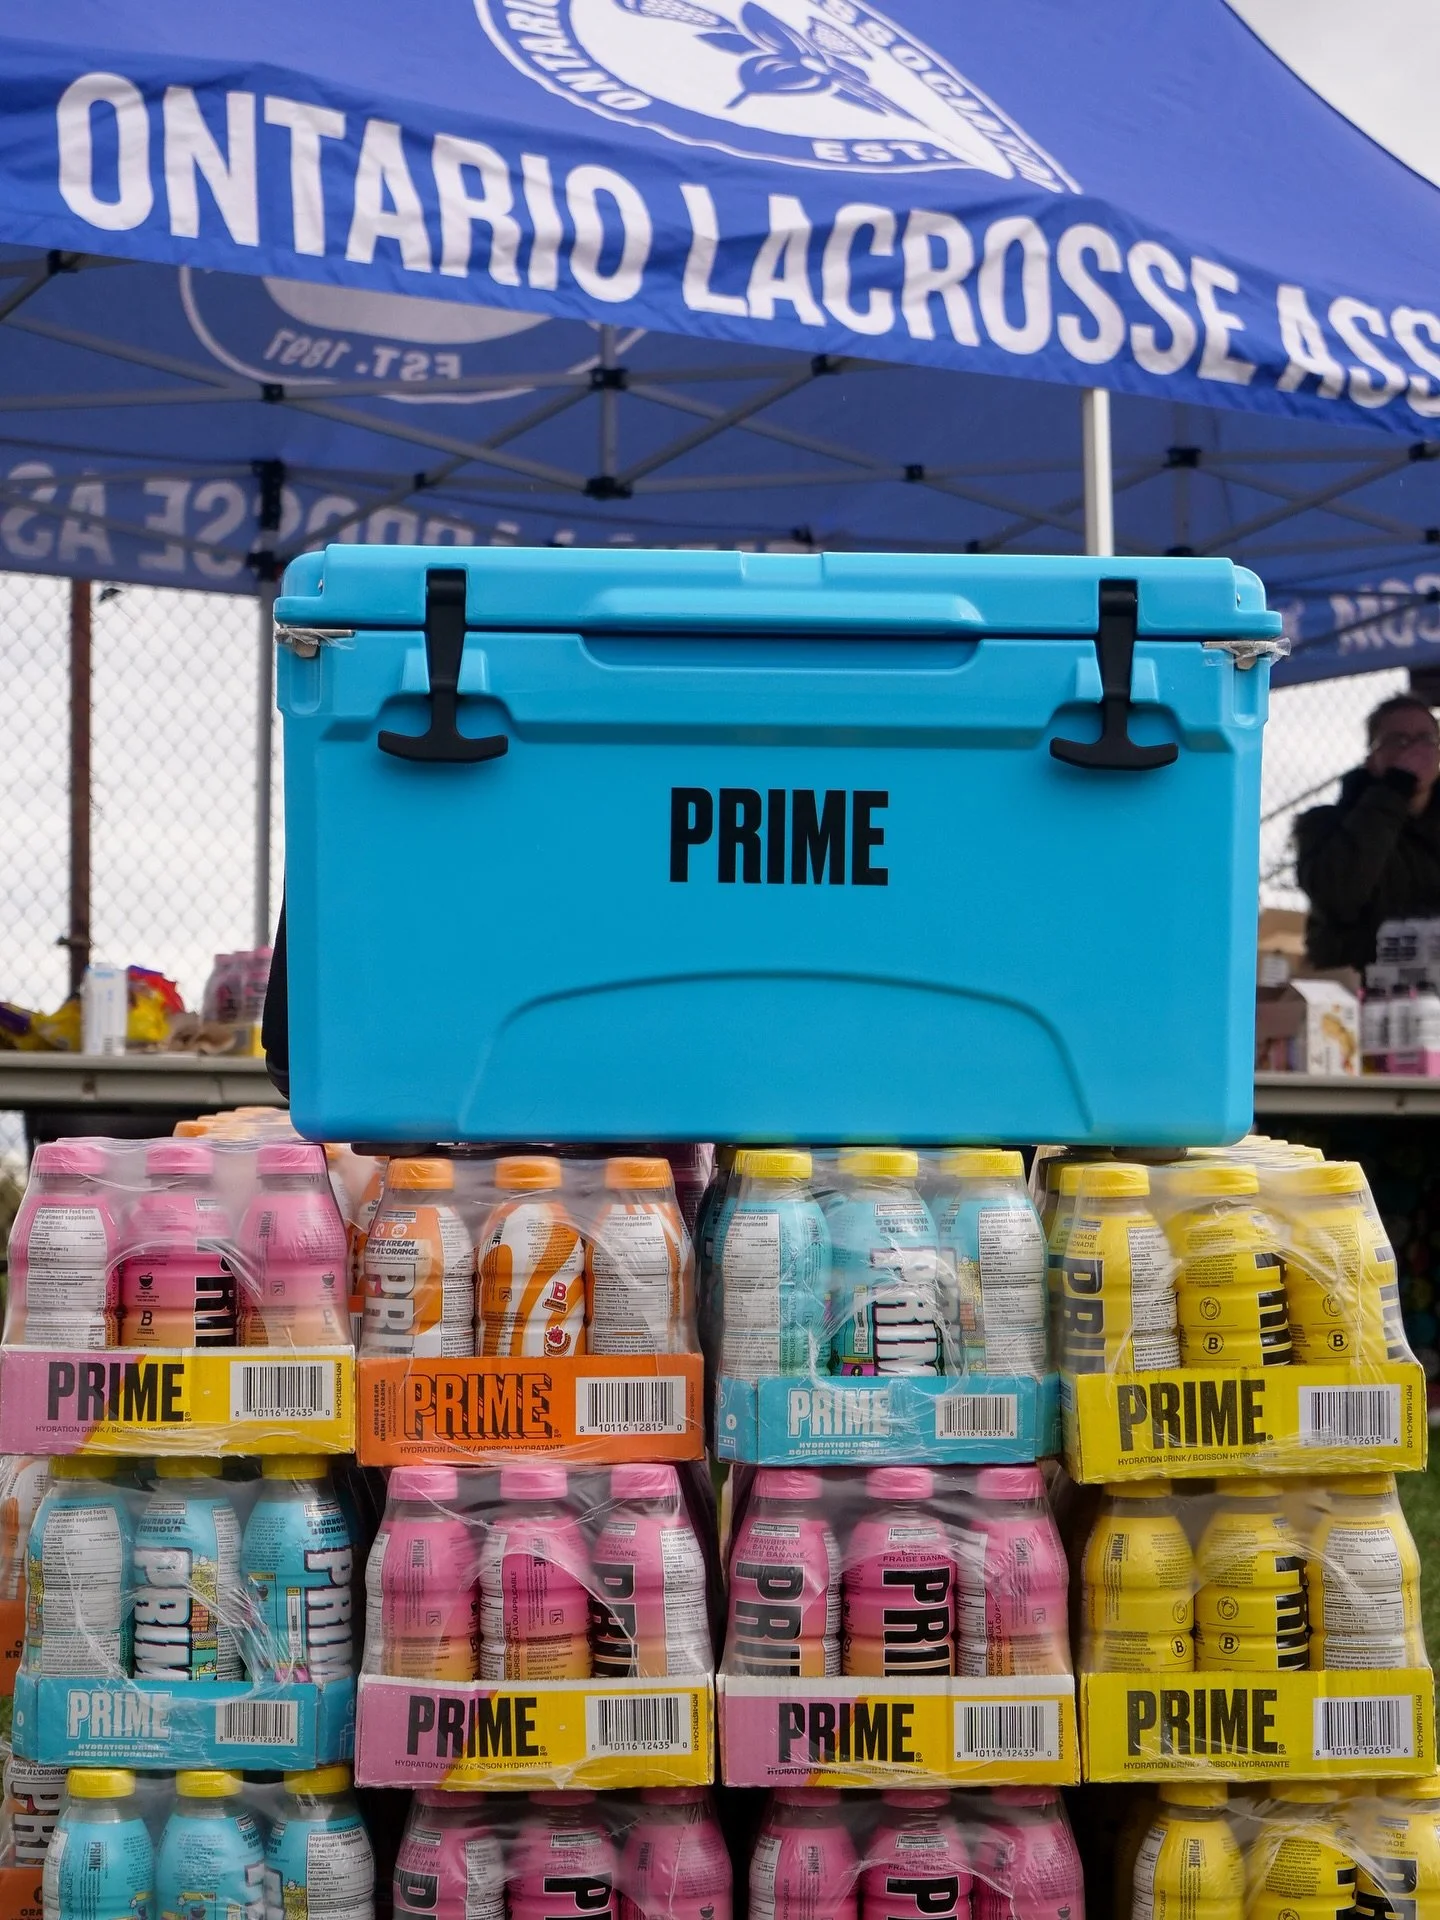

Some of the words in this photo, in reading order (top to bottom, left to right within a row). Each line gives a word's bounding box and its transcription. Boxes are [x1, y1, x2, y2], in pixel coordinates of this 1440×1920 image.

[811, 139, 949, 164] EST.
[56, 71, 653, 304] ONTARIO
[681, 183, 1256, 385] LACROSSE
[669, 786, 889, 886] PRIME
[140, 1310, 153, 1326] B
[1208, 1337, 1218, 1351] B
[1333, 1334, 1344, 1348] B
[47, 1361, 185, 1422] PRIME
[253, 1408, 281, 1417] 10116
[284, 1408, 313, 1417] 12435
[325, 1409, 331, 1417] 0
[404, 1373, 553, 1441] PRIME
[787, 1386, 892, 1439] PRIME
[1117, 1379, 1266, 1452] PRIME
[36, 1425, 80, 1433] HYDRATION
[579, 1425, 585, 1433] 8
[599, 1423, 628, 1432] 10116
[633, 1423, 663, 1431] 12815
[1353, 1436, 1381, 1445] 12615
[400, 1446, 445, 1454] HYDRATION
[1118, 1455, 1163, 1465] HYDRATION
[1163, 1453, 1187, 1463] DRINK
[1193, 1453, 1229, 1461] BOISSON
[413, 1539, 425, 1568] PRIME
[752, 1543, 787, 1552] BANANA
[765, 1550, 806, 1559] BANANE
[1111, 1533, 1125, 1562] PRIME
[511, 1571, 520, 1613] APPLICABLE
[1175, 1641, 1183, 1653] B
[1223, 1636, 1234, 1650] B
[67, 1689, 173, 1741] PRIME
[1126, 1688, 1278, 1756] PRIME
[406, 1695, 539, 1758] PRIME
[778, 1702, 915, 1763] PRIME
[78, 1743, 131, 1751] HYDRATION
[609, 1742, 638, 1751] 10116
[641, 1741, 670, 1750] 12435
[1315, 1749, 1320, 1757] 8
[1331, 1747, 1359, 1756] 10116
[1363, 1746, 1391, 1755] 12615
[974, 1750, 1003, 1758] 10116
[1007, 1750, 1035, 1758] 12435
[395, 1760, 439, 1769] HYDRATION
[440, 1762, 464, 1770] DRINK
[1238, 1760, 1290, 1768] HYDRATANTE
[89, 1842, 101, 1871] PRIME
[638, 1842, 650, 1871] PRIME
[1189, 1839, 1201, 1868] PRIME
